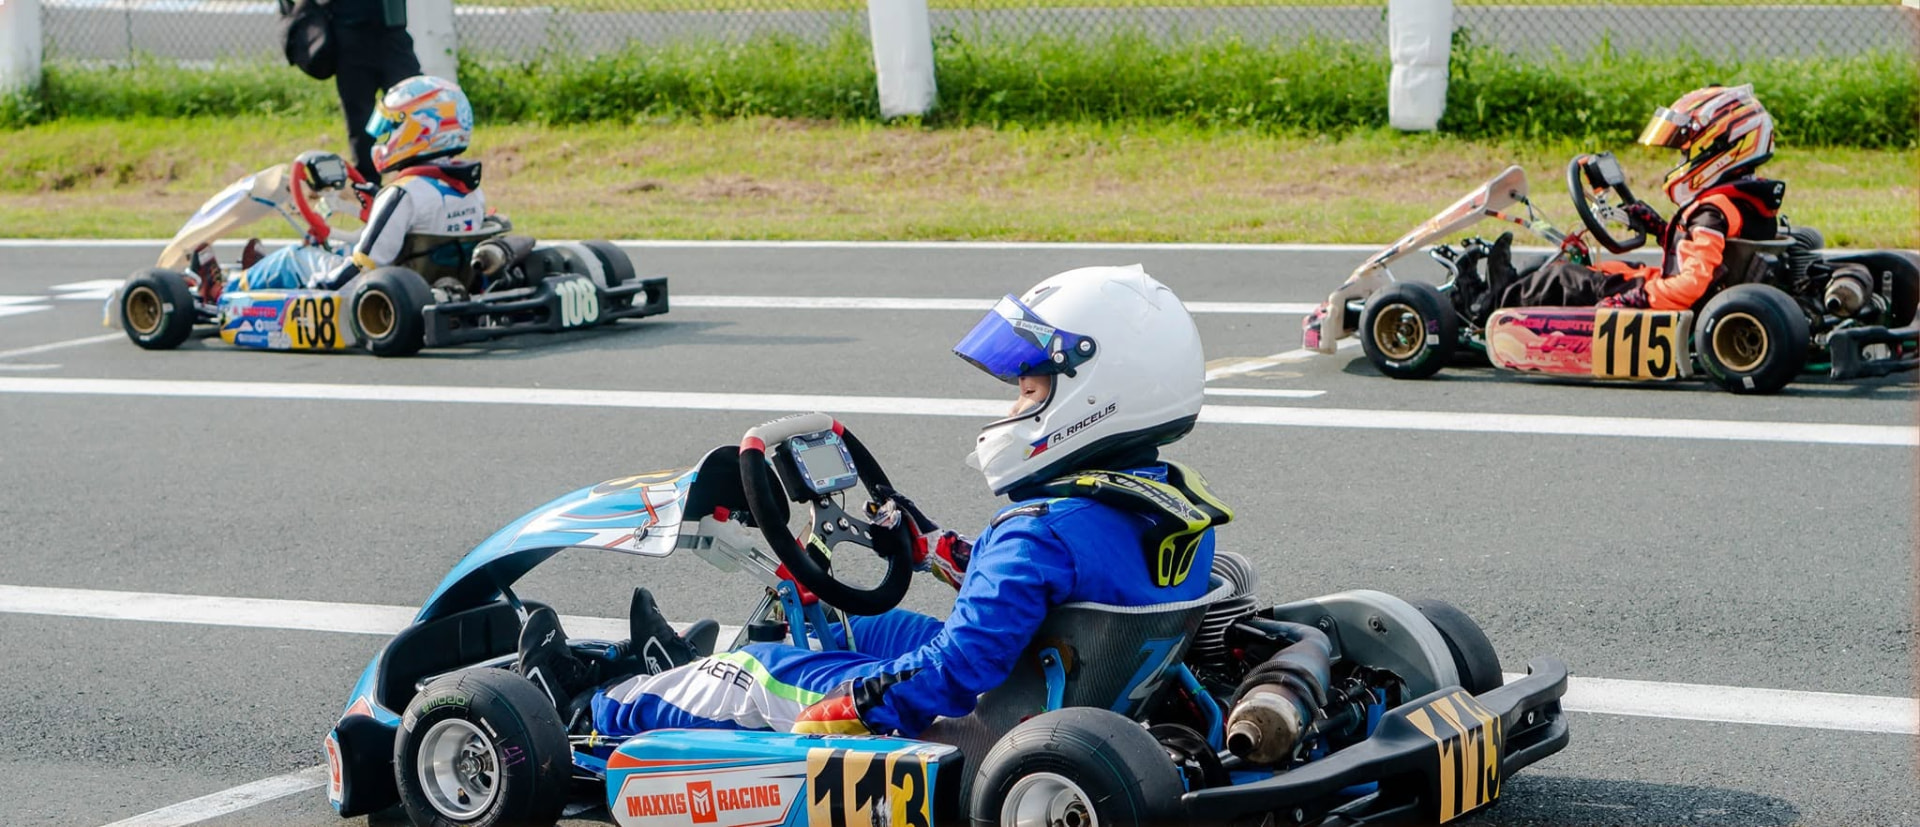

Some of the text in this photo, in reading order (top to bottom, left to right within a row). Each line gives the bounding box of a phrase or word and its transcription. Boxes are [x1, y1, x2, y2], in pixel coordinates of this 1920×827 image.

[291, 296, 336, 348] 108
[554, 277, 599, 327] 108
[1599, 311, 1672, 378] 115
[1066, 402, 1116, 436] RACELIS
[626, 784, 782, 818] MAXXIS RACING
[814, 749, 931, 827] 113
